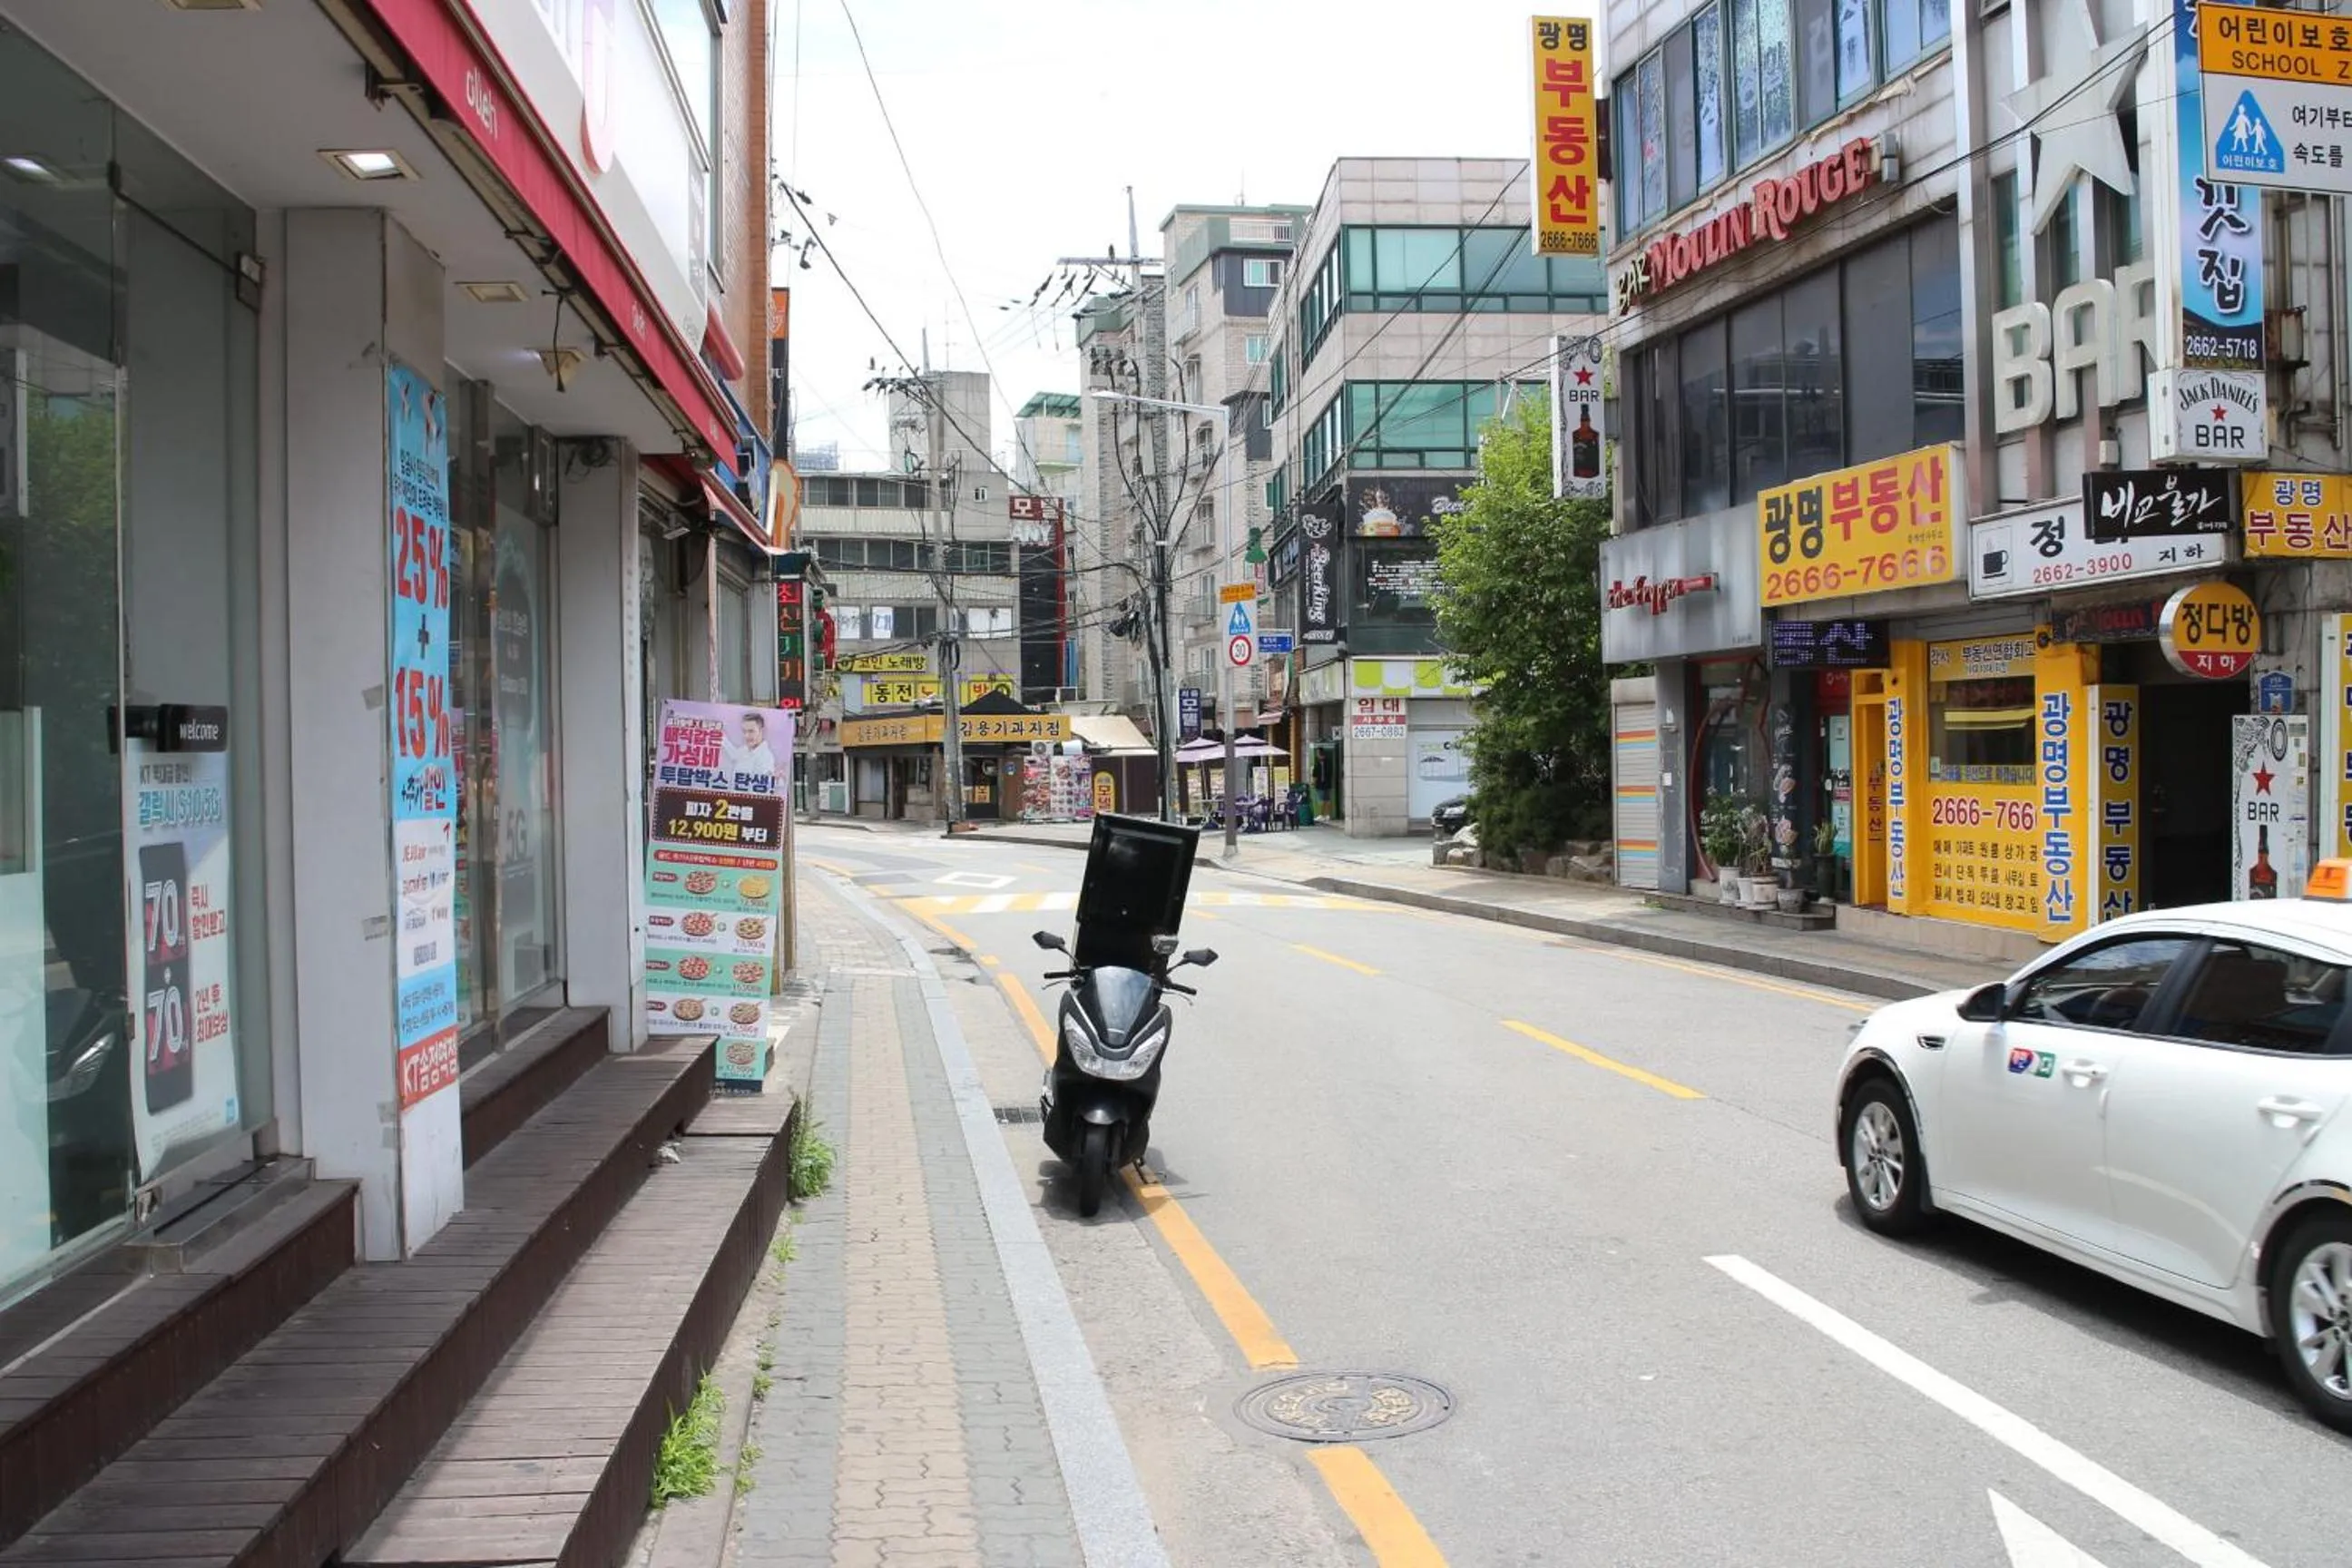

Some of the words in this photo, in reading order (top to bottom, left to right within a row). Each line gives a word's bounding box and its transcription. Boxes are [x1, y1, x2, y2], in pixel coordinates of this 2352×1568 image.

[1538, 22, 1587, 52] 광명
[2232, 50, 2321, 76] SCHOOL
[1543, 58, 1590, 223] 부동산
[2222, 154, 2279, 170] 어린이보호
[2294, 143, 2344, 168] 속도를
[1541, 230, 1597, 249] 2666-7666
[1618, 253, 1651, 316] BAR
[1648, 202, 1757, 293] MOULIN
[1753, 137, 1874, 242] ROUGE
[1993, 265, 2157, 434] BAR
[2186, 335, 2258, 359] 2662-5718
[1569, 389, 1600, 402] BAR
[2179, 383, 2210, 411] JACK
[2210, 377, 2259, 414] DANIEL'S
[2195, 424, 2245, 449] BAR
[2101, 474, 2222, 529] 비교불가
[2275, 479, 2323, 506] 광명
[1765, 486, 1824, 564] 광명
[1830, 456, 1944, 542] 부동산
[2248, 509, 2352, 551] 부동산
[395, 507, 448, 610] 25%
[2159, 544, 2205, 564] 지하
[1767, 544, 1946, 600] 2666-7666
[2034, 553, 2133, 584] 2662-3900
[2181, 603, 2254, 644] 정다방
[858, 659, 883, 670] 코인
[887, 655, 926, 670] 노래방
[1234, 642, 1248, 658] 30
[2197, 652, 2237, 671] 지하
[395, 667, 450, 760] 15%
[1357, 698, 1400, 712] 임대
[180, 718, 219, 740] welcome
[959, 721, 1060, 738] 김용기과자점
[2104, 701, 2133, 782] 광명
[662, 742, 722, 769] 가성비
[660, 766, 729, 789] 투탑박스
[734, 772, 776, 795] 탄생!
[685, 800, 711, 817] 피자
[1932, 797, 2037, 831] 2666-766
[2042, 692, 2075, 923] 광명부동산
[2248, 801, 2279, 821] BAR
[669, 818, 739, 841] 12,900원
[741, 827, 768, 843] 부터
[2004, 844, 2025, 860] 상가
[145, 878, 180, 952] 70
[148, 985, 183, 1062] 70
